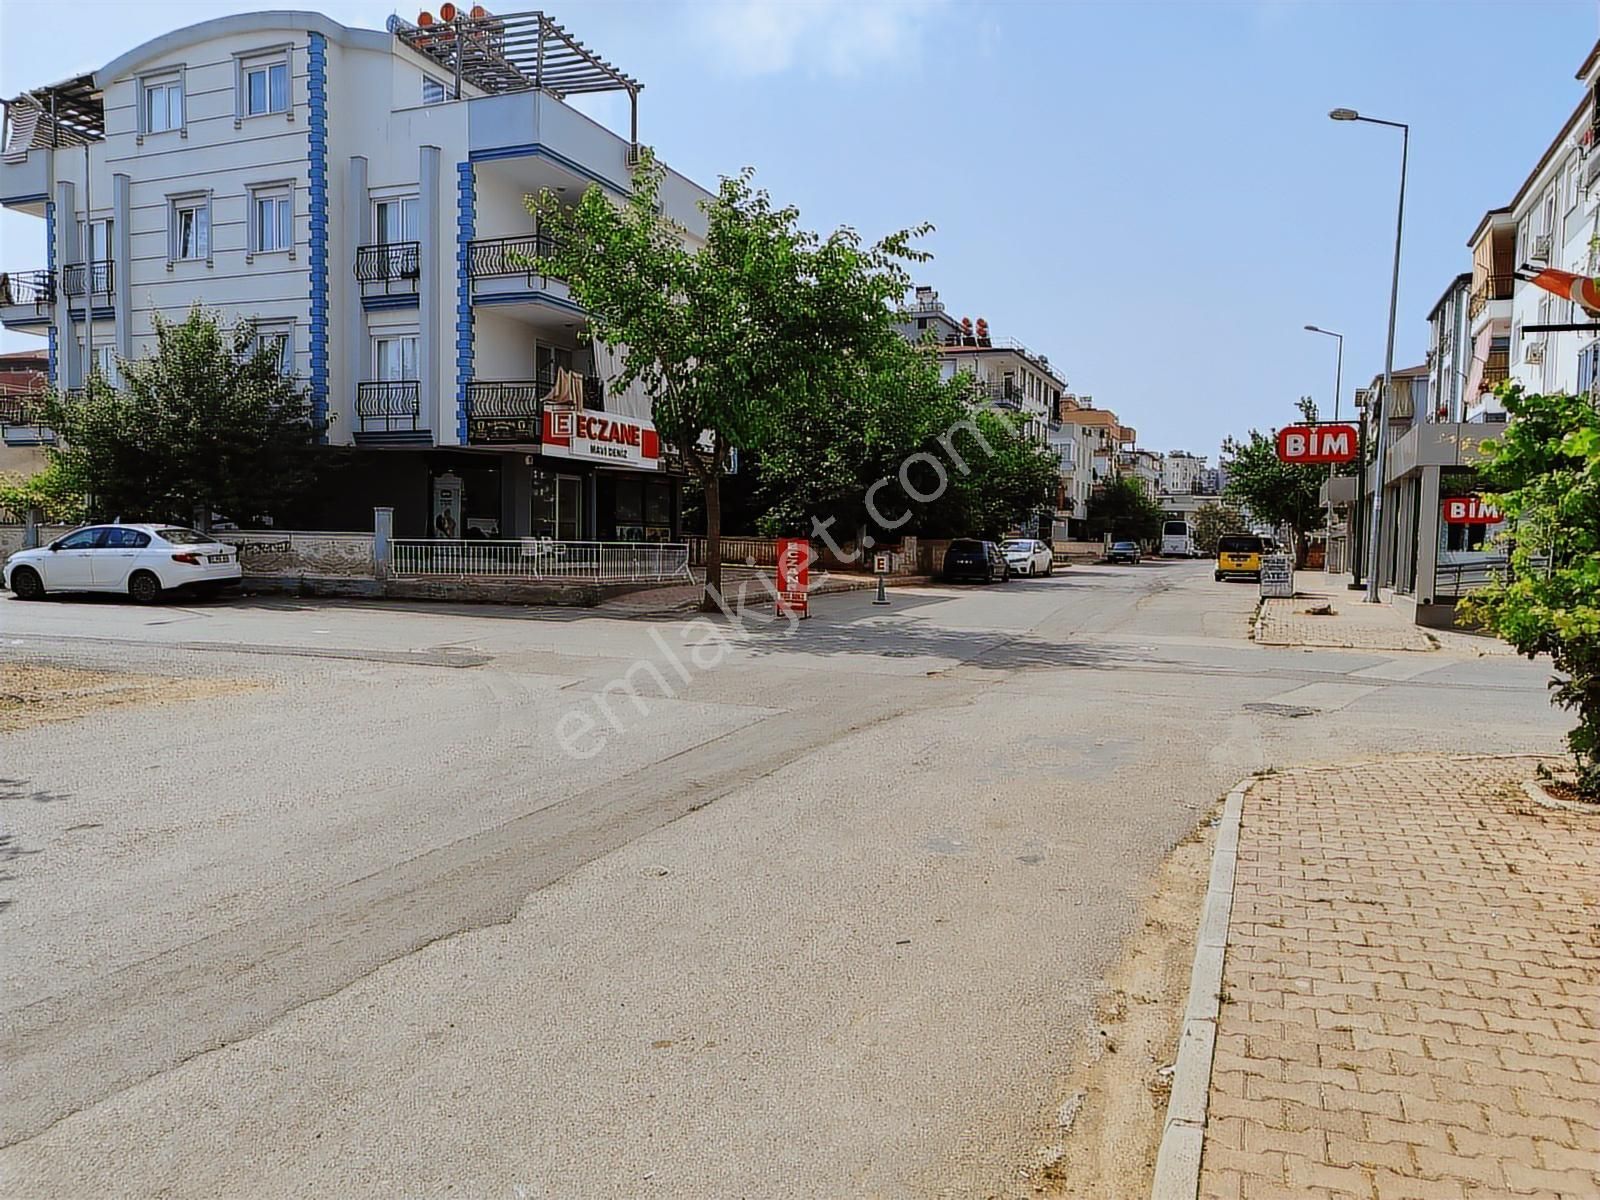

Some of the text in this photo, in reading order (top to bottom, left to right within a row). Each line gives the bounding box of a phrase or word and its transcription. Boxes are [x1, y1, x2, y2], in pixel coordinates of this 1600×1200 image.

[557, 415, 641, 446] E ECZANE
[877, 557, 885, 570] E
